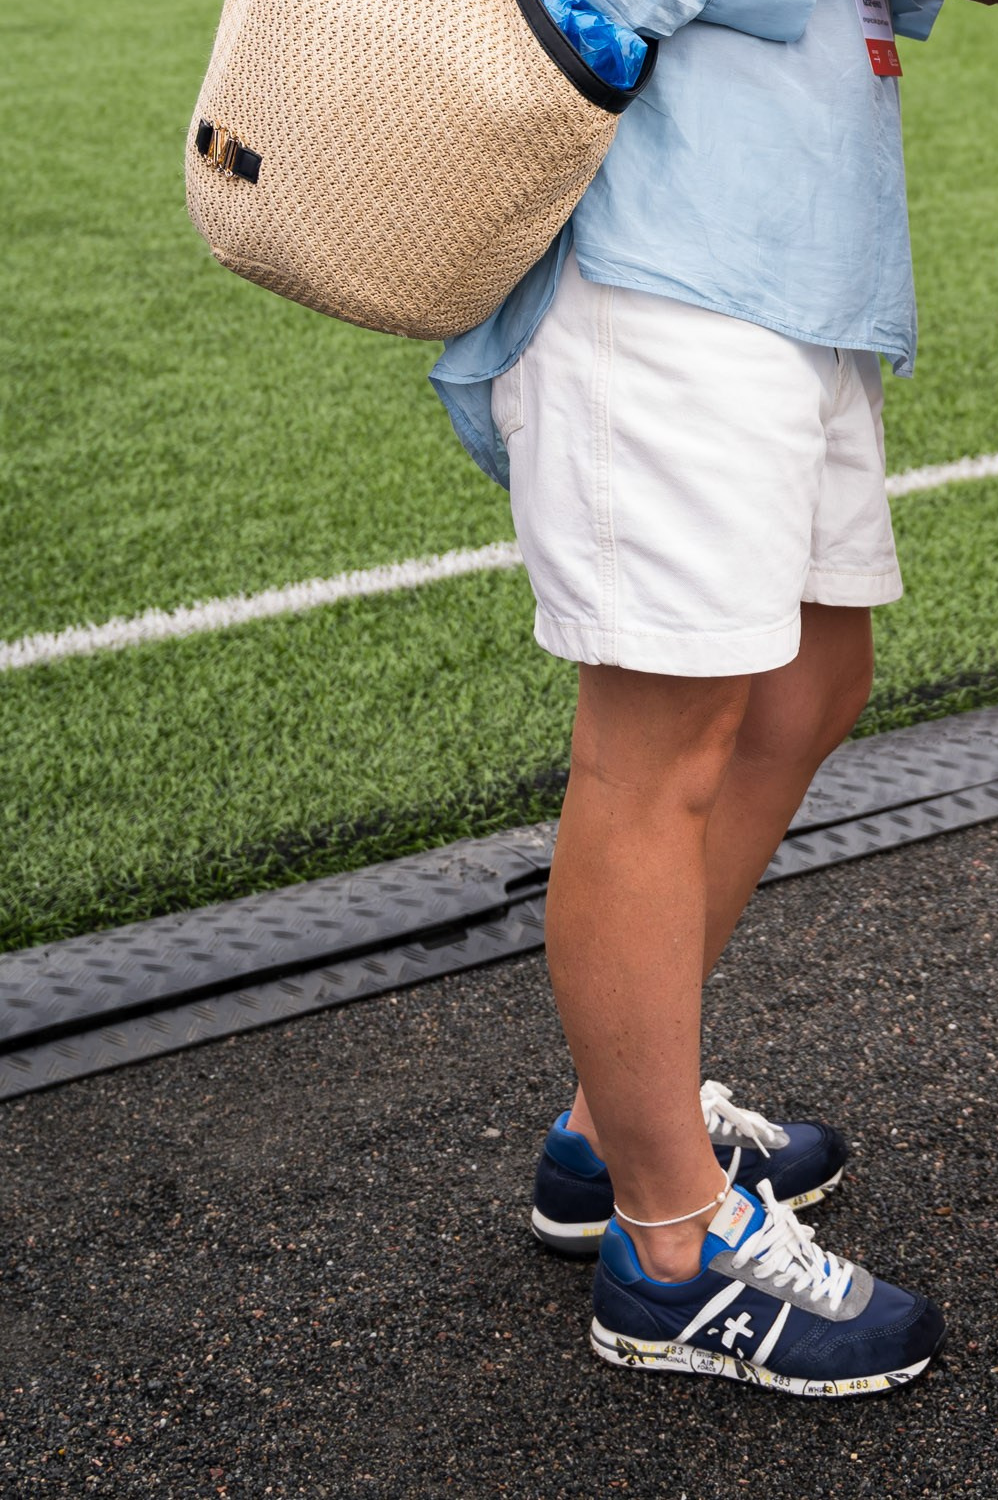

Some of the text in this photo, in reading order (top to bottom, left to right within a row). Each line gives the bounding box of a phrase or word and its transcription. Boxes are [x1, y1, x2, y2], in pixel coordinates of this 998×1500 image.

[663, 1344, 684, 1355] 483
[700, 1358, 715, 1367] AIR
[696, 1365, 717, 1373] FORCE
[772, 1374, 791, 1387] 483
[849, 1379, 869, 1390] 483
